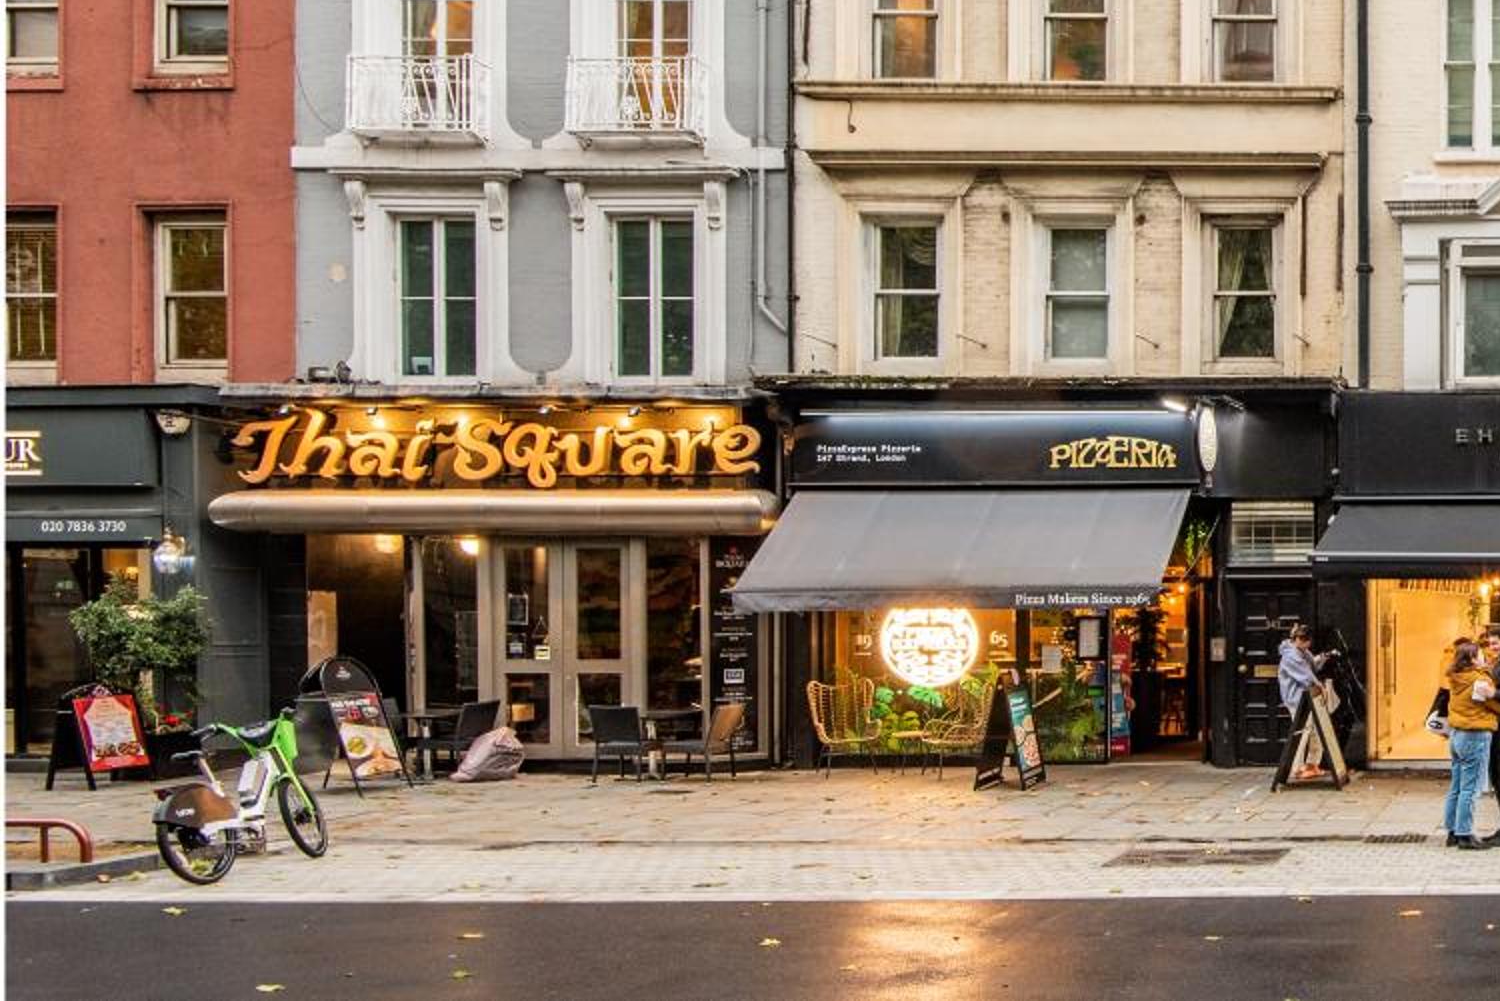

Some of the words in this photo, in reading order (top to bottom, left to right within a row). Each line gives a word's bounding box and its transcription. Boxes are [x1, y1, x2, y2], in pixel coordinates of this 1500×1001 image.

[231, 407, 437, 485] Thai
[435, 417, 762, 489] Square
[1049, 436, 1177, 468] PIZZERIA
[67, 520, 95, 532] 7836
[98, 520, 127, 532] 3730
[1015, 593, 1045, 605] Pizza
[1048, 593, 1089, 605] Makers
[1091, 593, 1123, 605] Since
[990, 631, 1008, 647] 65
